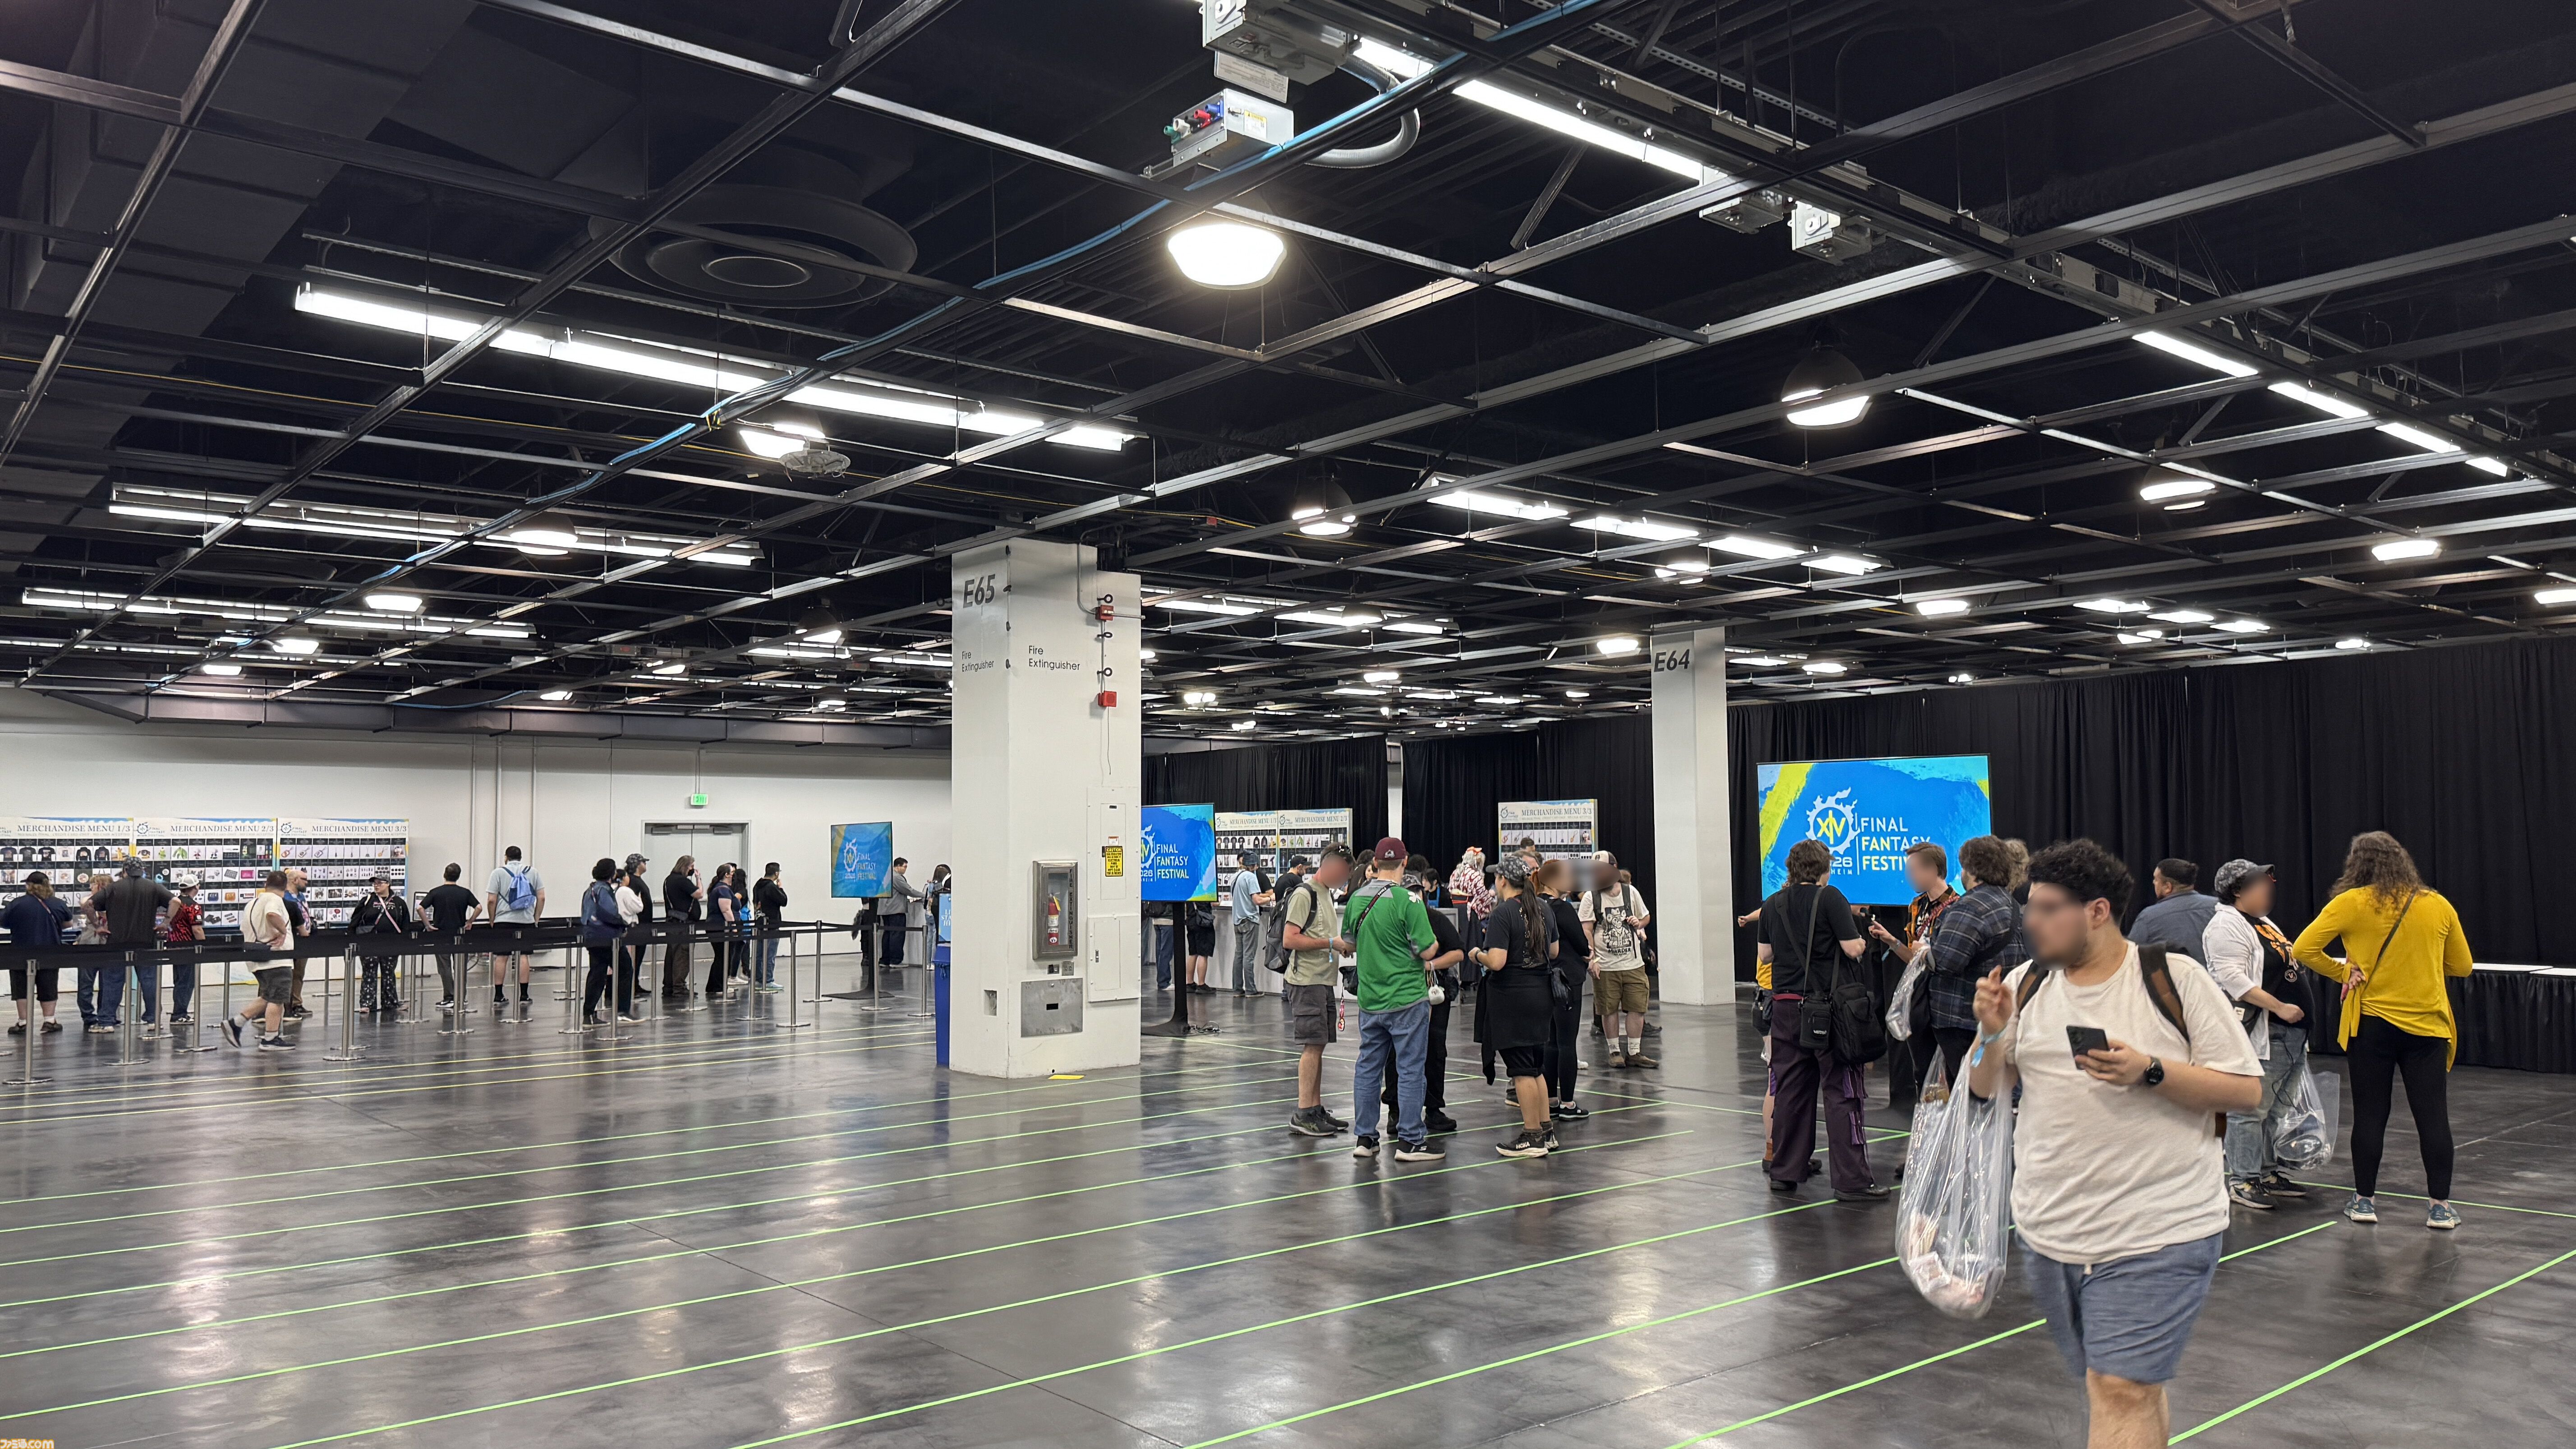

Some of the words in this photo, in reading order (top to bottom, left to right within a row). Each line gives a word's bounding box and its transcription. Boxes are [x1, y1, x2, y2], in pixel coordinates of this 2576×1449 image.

[963, 574, 995, 608] E65
[962, 651, 971, 660] Fire
[1029, 645, 1044, 655] Fire
[961, 660, 994, 672] Extinguisher
[1029, 658, 1081, 671] Extinguisher
[1654, 649, 1690, 672] E64
[1861, 817, 1909, 832] FINAL
[1156, 843, 1178, 854] FINAL
[858, 852, 870, 860] FINAL
[1156, 856, 1188, 866] FANTASY
[1830, 856, 1853, 867] 26
[1862, 856, 1909, 871] FESTI
[1157, 869, 1189, 879] FESTIVAL
